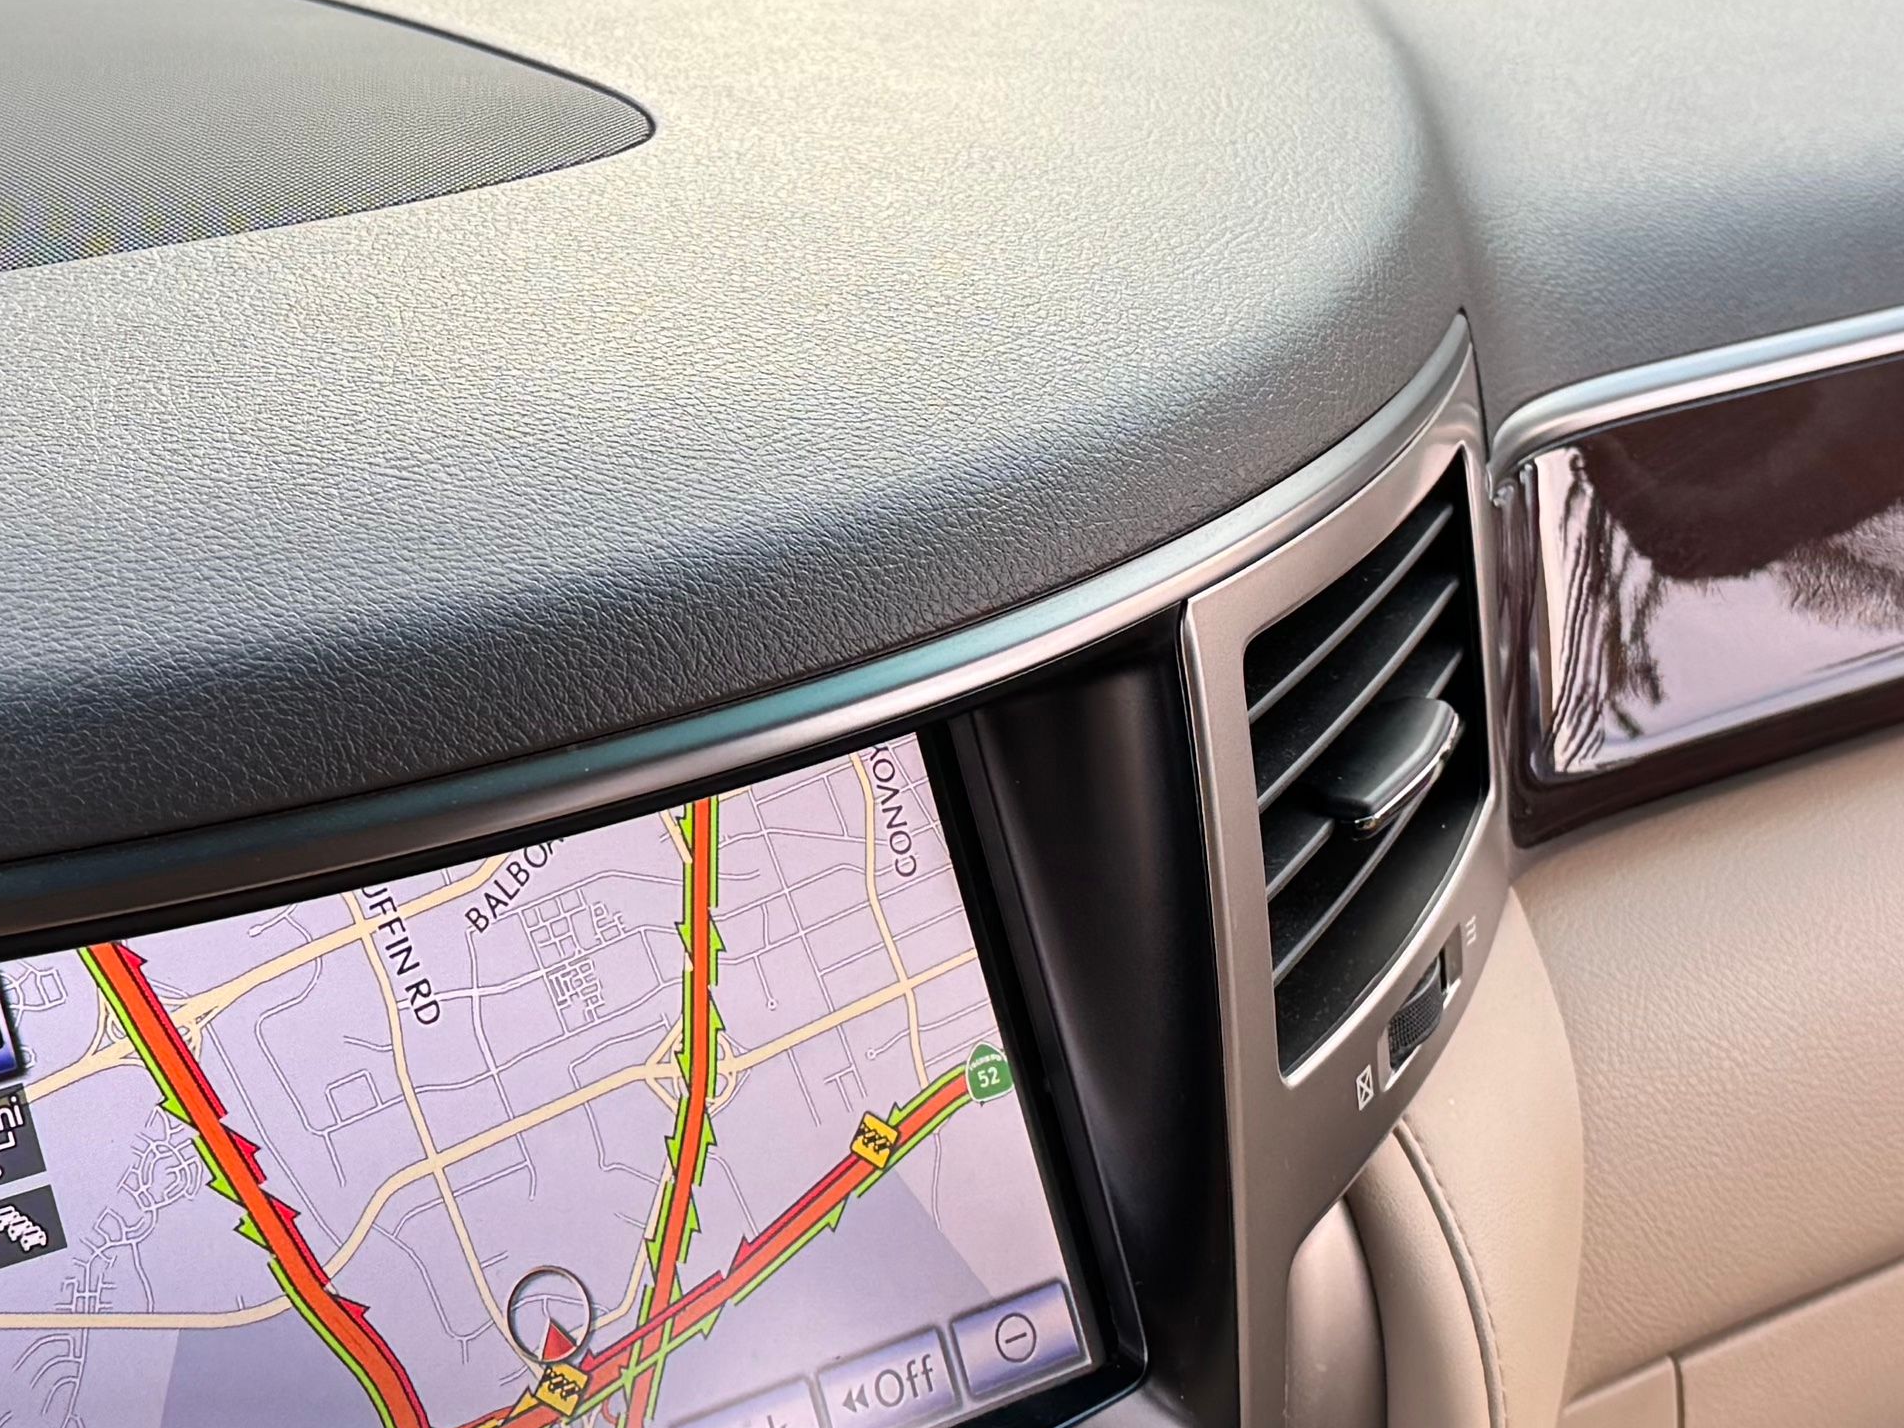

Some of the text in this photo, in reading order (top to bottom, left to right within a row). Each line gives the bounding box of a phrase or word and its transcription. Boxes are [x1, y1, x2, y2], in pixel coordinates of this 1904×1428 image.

[404, 977, 441, 1026] RD
[977, 1066, 1001, 1088] 52
[873, 1353, 936, 1409] Off
